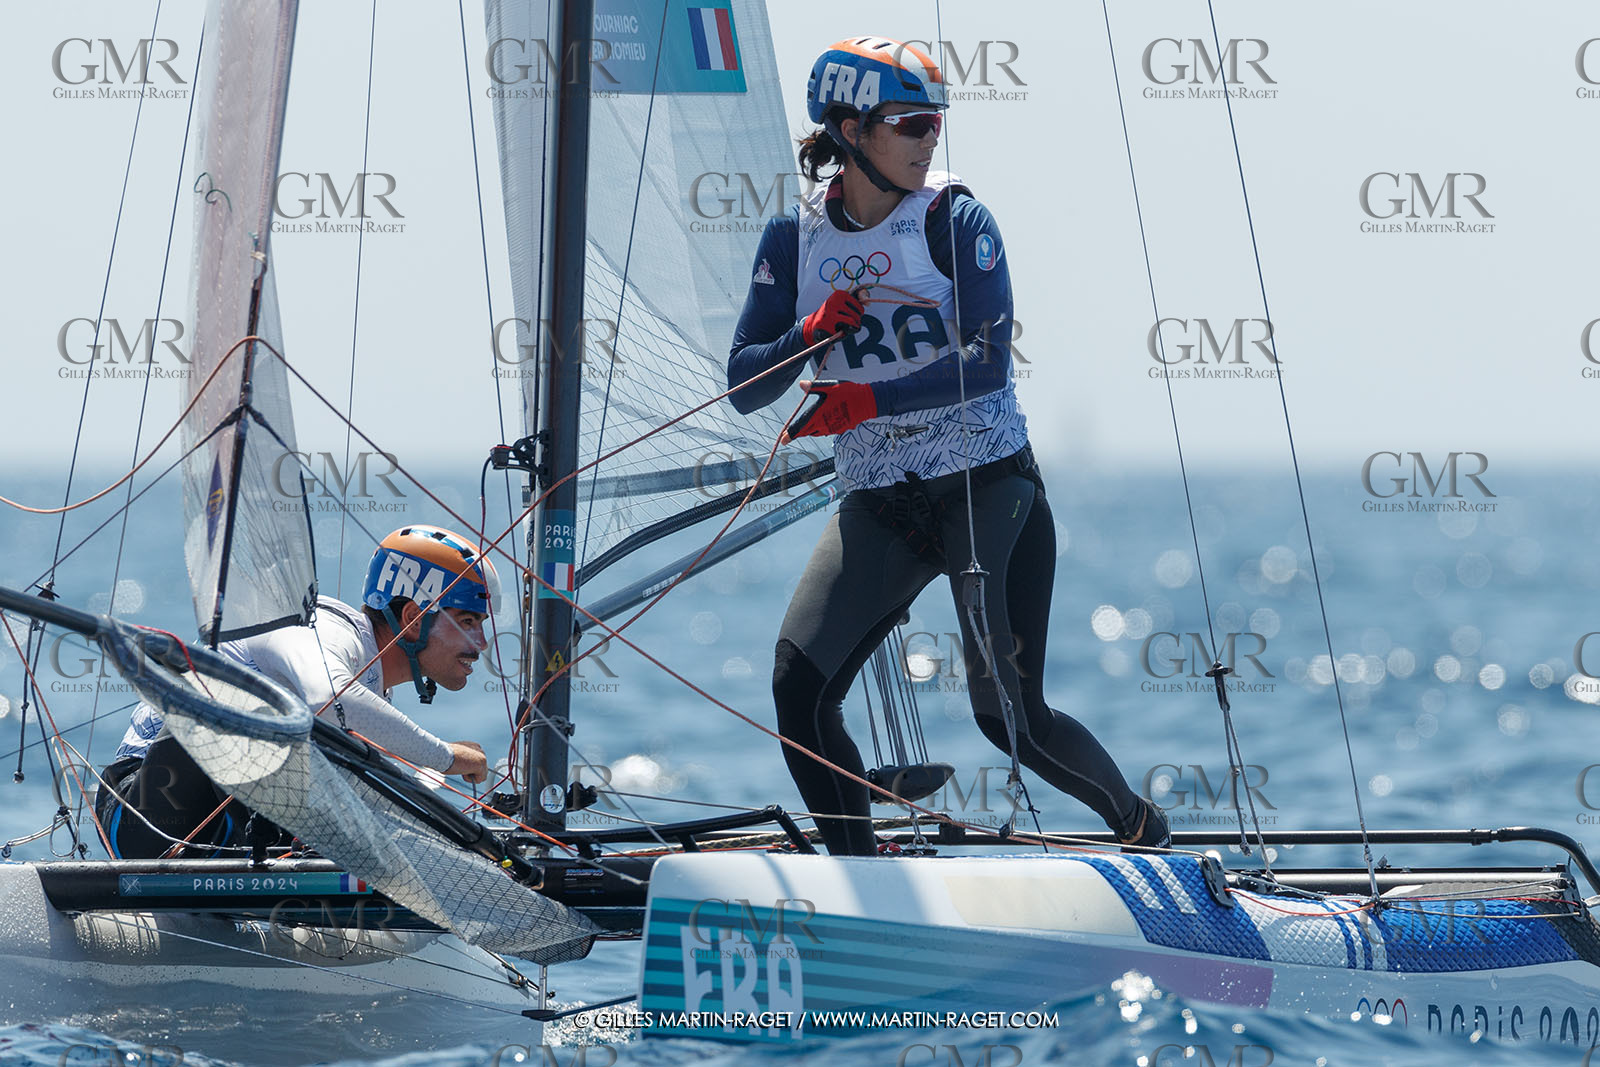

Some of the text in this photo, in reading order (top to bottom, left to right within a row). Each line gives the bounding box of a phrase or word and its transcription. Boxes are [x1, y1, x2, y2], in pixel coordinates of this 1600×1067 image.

[594, 15, 639, 34] OURNIAC
[818, 62, 880, 112] FRA
[377, 551, 445, 612] FRA
[252, 877, 298, 890] 2024
[680, 925, 803, 1040] FRA
